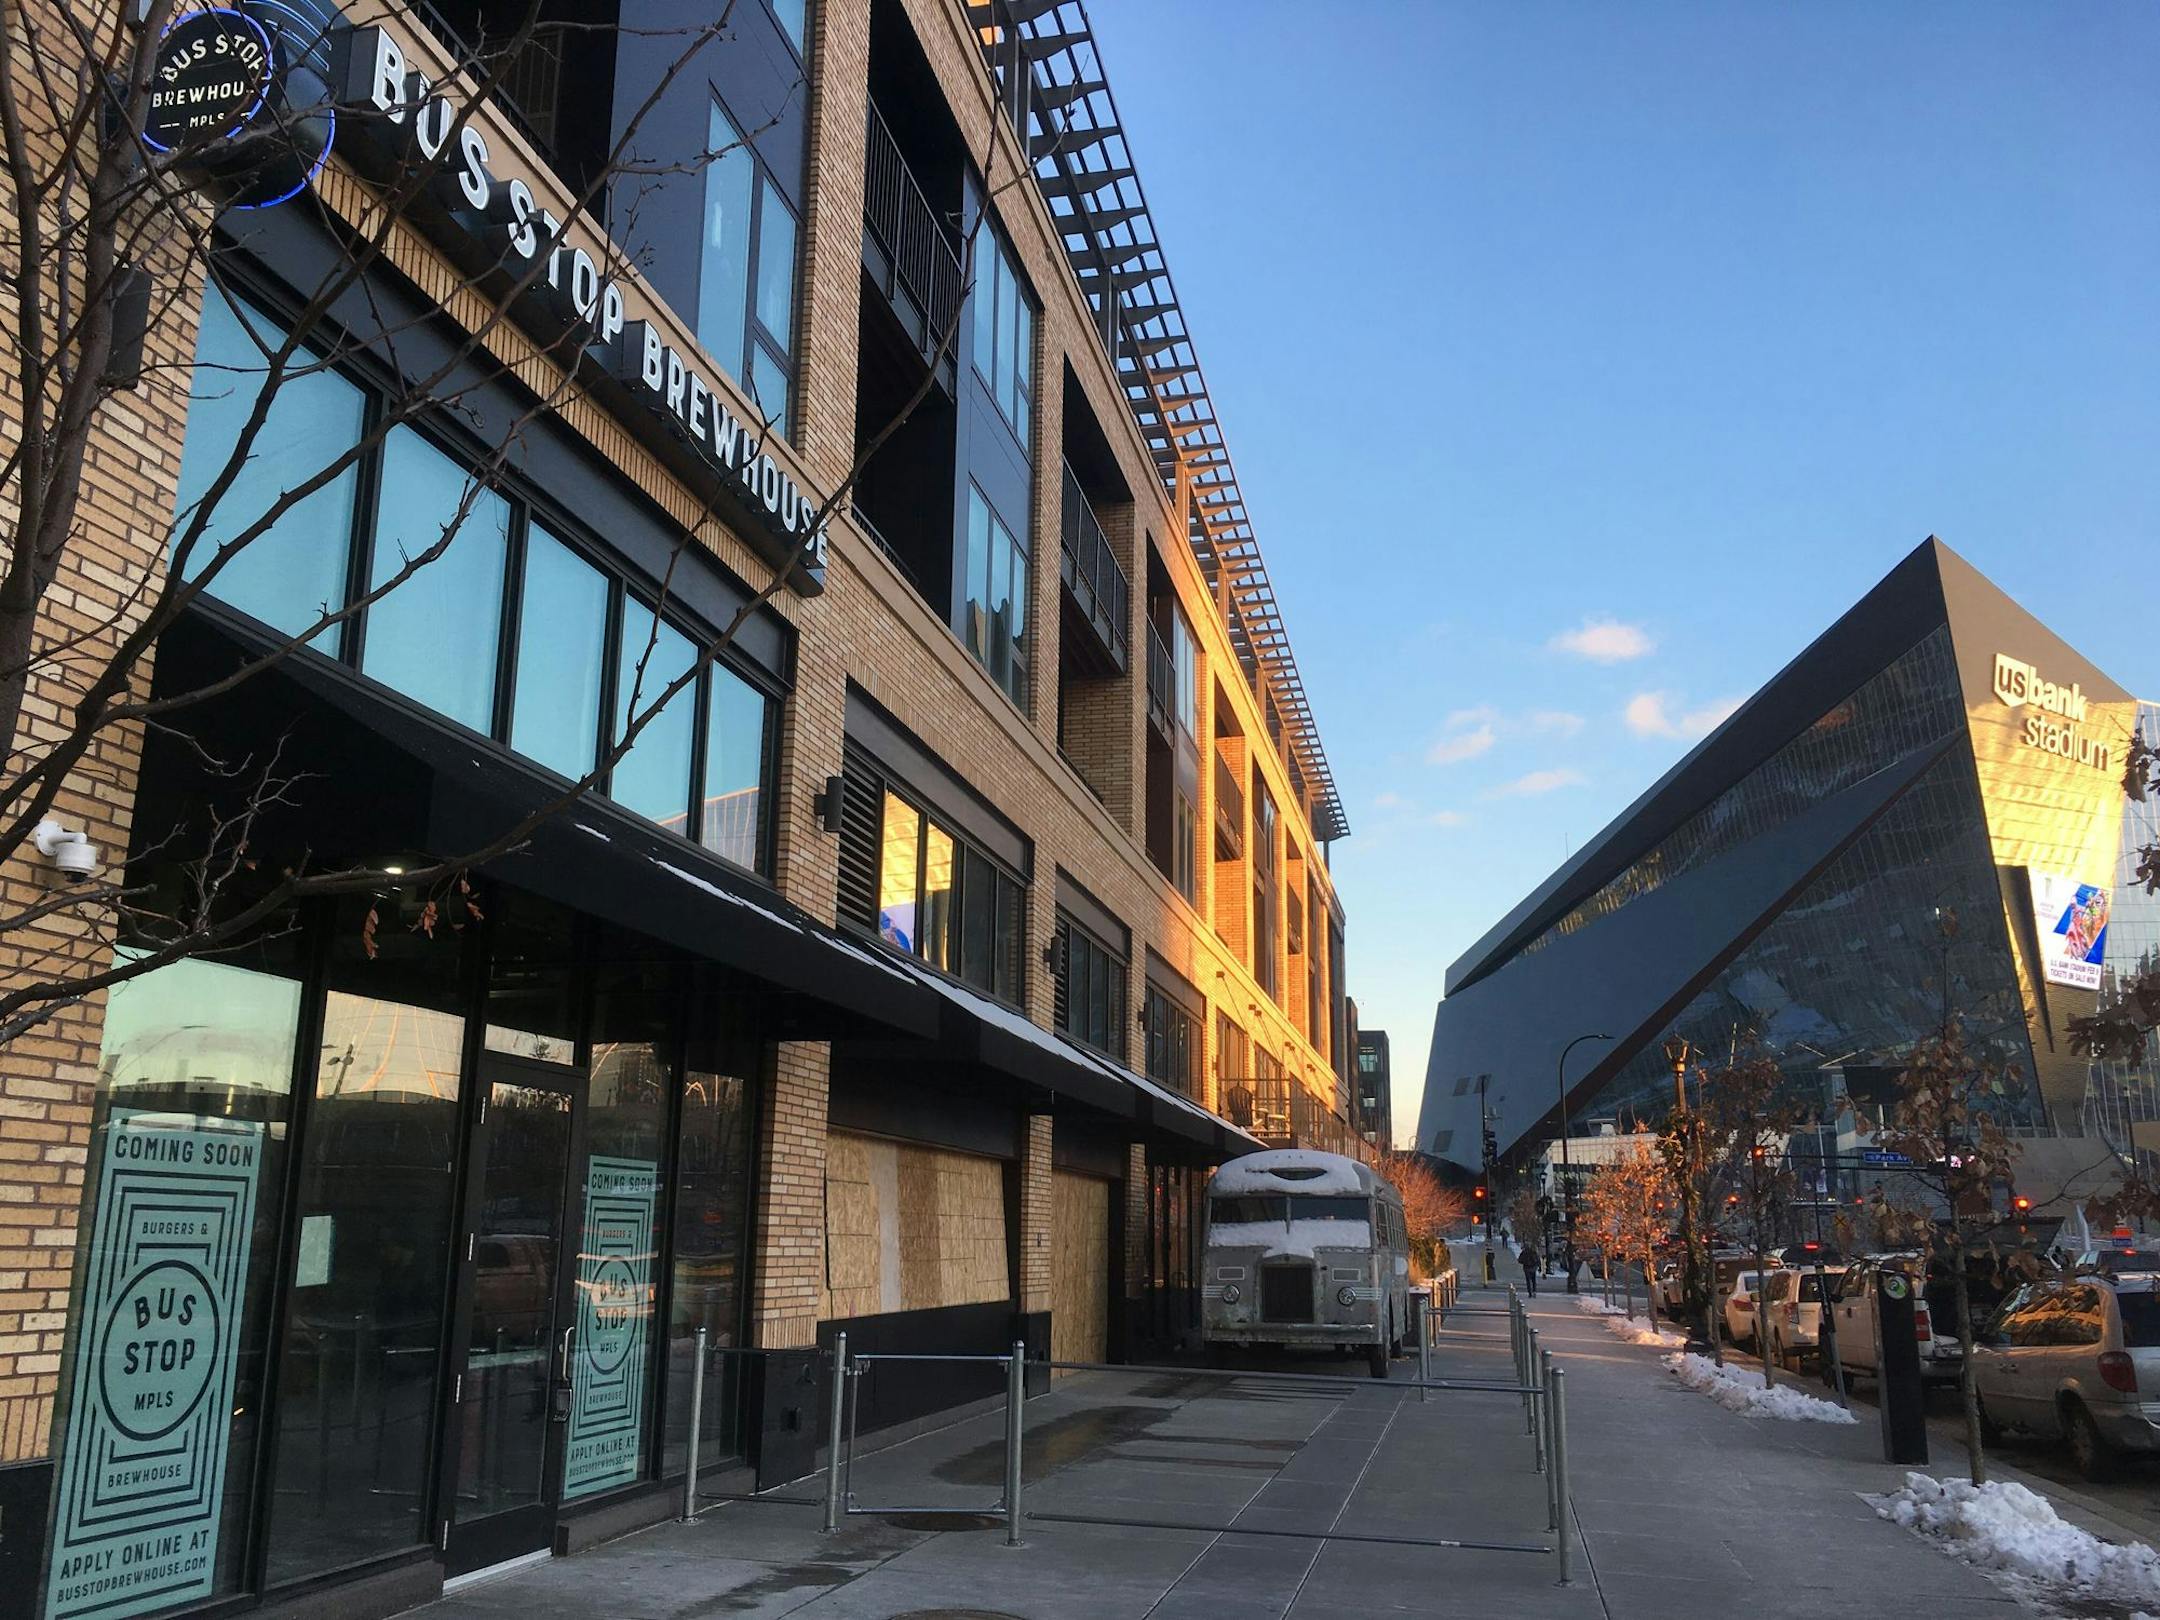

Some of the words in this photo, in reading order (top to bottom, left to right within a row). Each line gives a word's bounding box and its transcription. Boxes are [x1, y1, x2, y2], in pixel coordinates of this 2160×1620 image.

[160, 38, 207, 82] BUS
[371, 25, 490, 211] BUS
[507, 178, 624, 346] STOP
[641, 318, 829, 570] BREWHOUSE
[2025, 714, 2110, 771] stadium
[115, 1135, 194, 1163] COMING
[203, 1142, 254, 1167] SOON
[592, 1174, 626, 1191] COMING
[629, 1175, 655, 1192] SOON
[142, 1221, 194, 1236] BURGERS
[201, 1223, 208, 1235] &
[134, 1288, 197, 1330] BUS
[595, 1305, 627, 1331] STOP
[123, 1338, 195, 1375] STOP
[134, 1390, 174, 1411] MPLS
[108, 1464, 182, 1488] BREWHOUSE
[60, 1549, 114, 1580] APPLY
[122, 1535, 182, 1565] ONLINE
[189, 1529, 210, 1552] AT
[57, 1556, 207, 1603] BUSSTOPBREWHOUSE.COM
